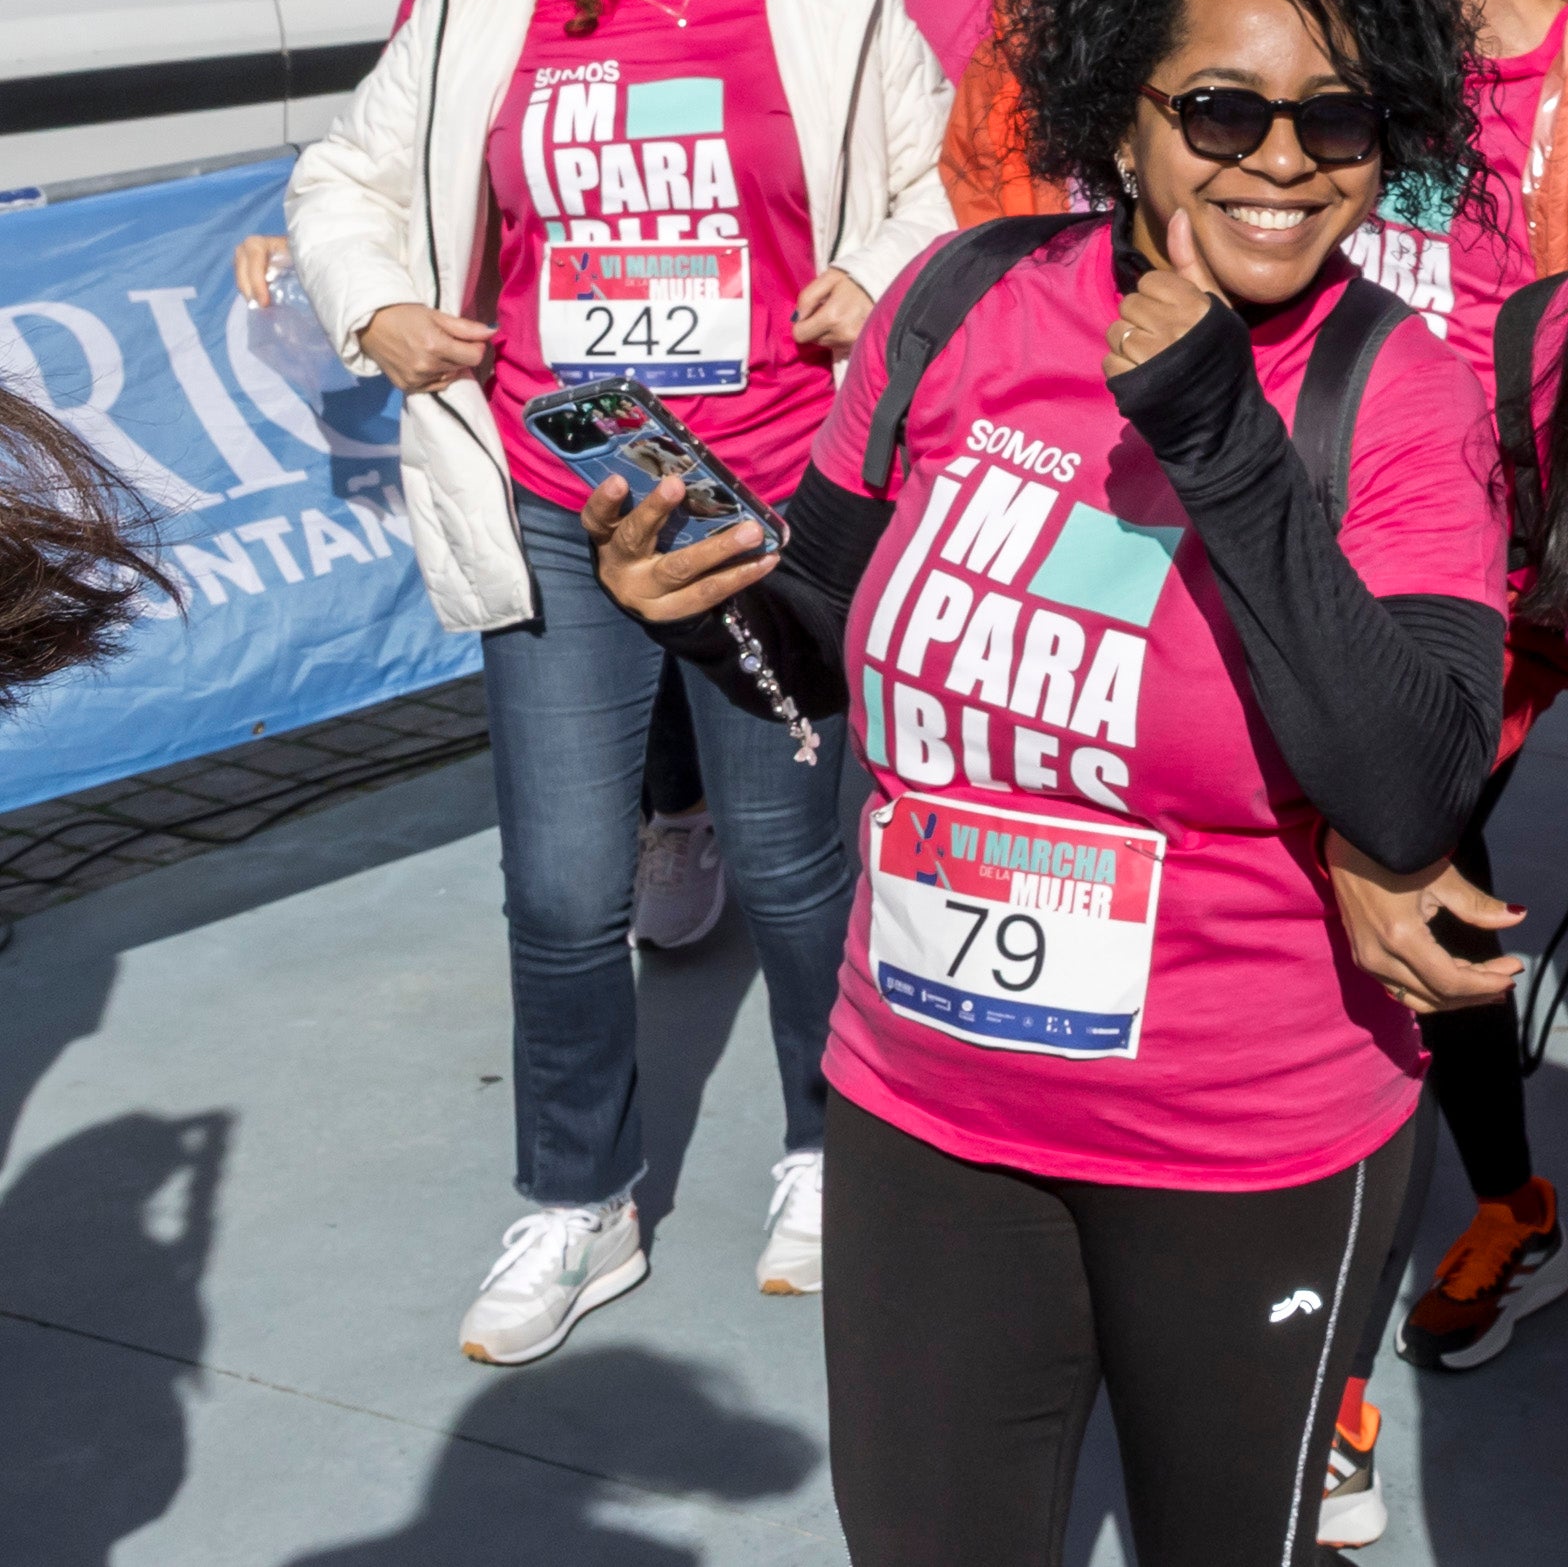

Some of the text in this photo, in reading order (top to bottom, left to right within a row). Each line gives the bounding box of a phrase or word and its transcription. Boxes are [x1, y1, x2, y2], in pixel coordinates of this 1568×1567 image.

[553, 138, 739, 217] PARA
[600, 255, 719, 278] VI MARCHA
[649, 278, 720, 300] MUJER
[585, 306, 701, 356] 242
[966, 419, 1081, 482] SOMOS
[896, 568, 1147, 748] PARA
[894, 681, 1130, 813] BLES
[950, 823, 1117, 885] VI MARCHA
[1009, 872, 1114, 920] MUJER
[945, 899, 1047, 992] 79
